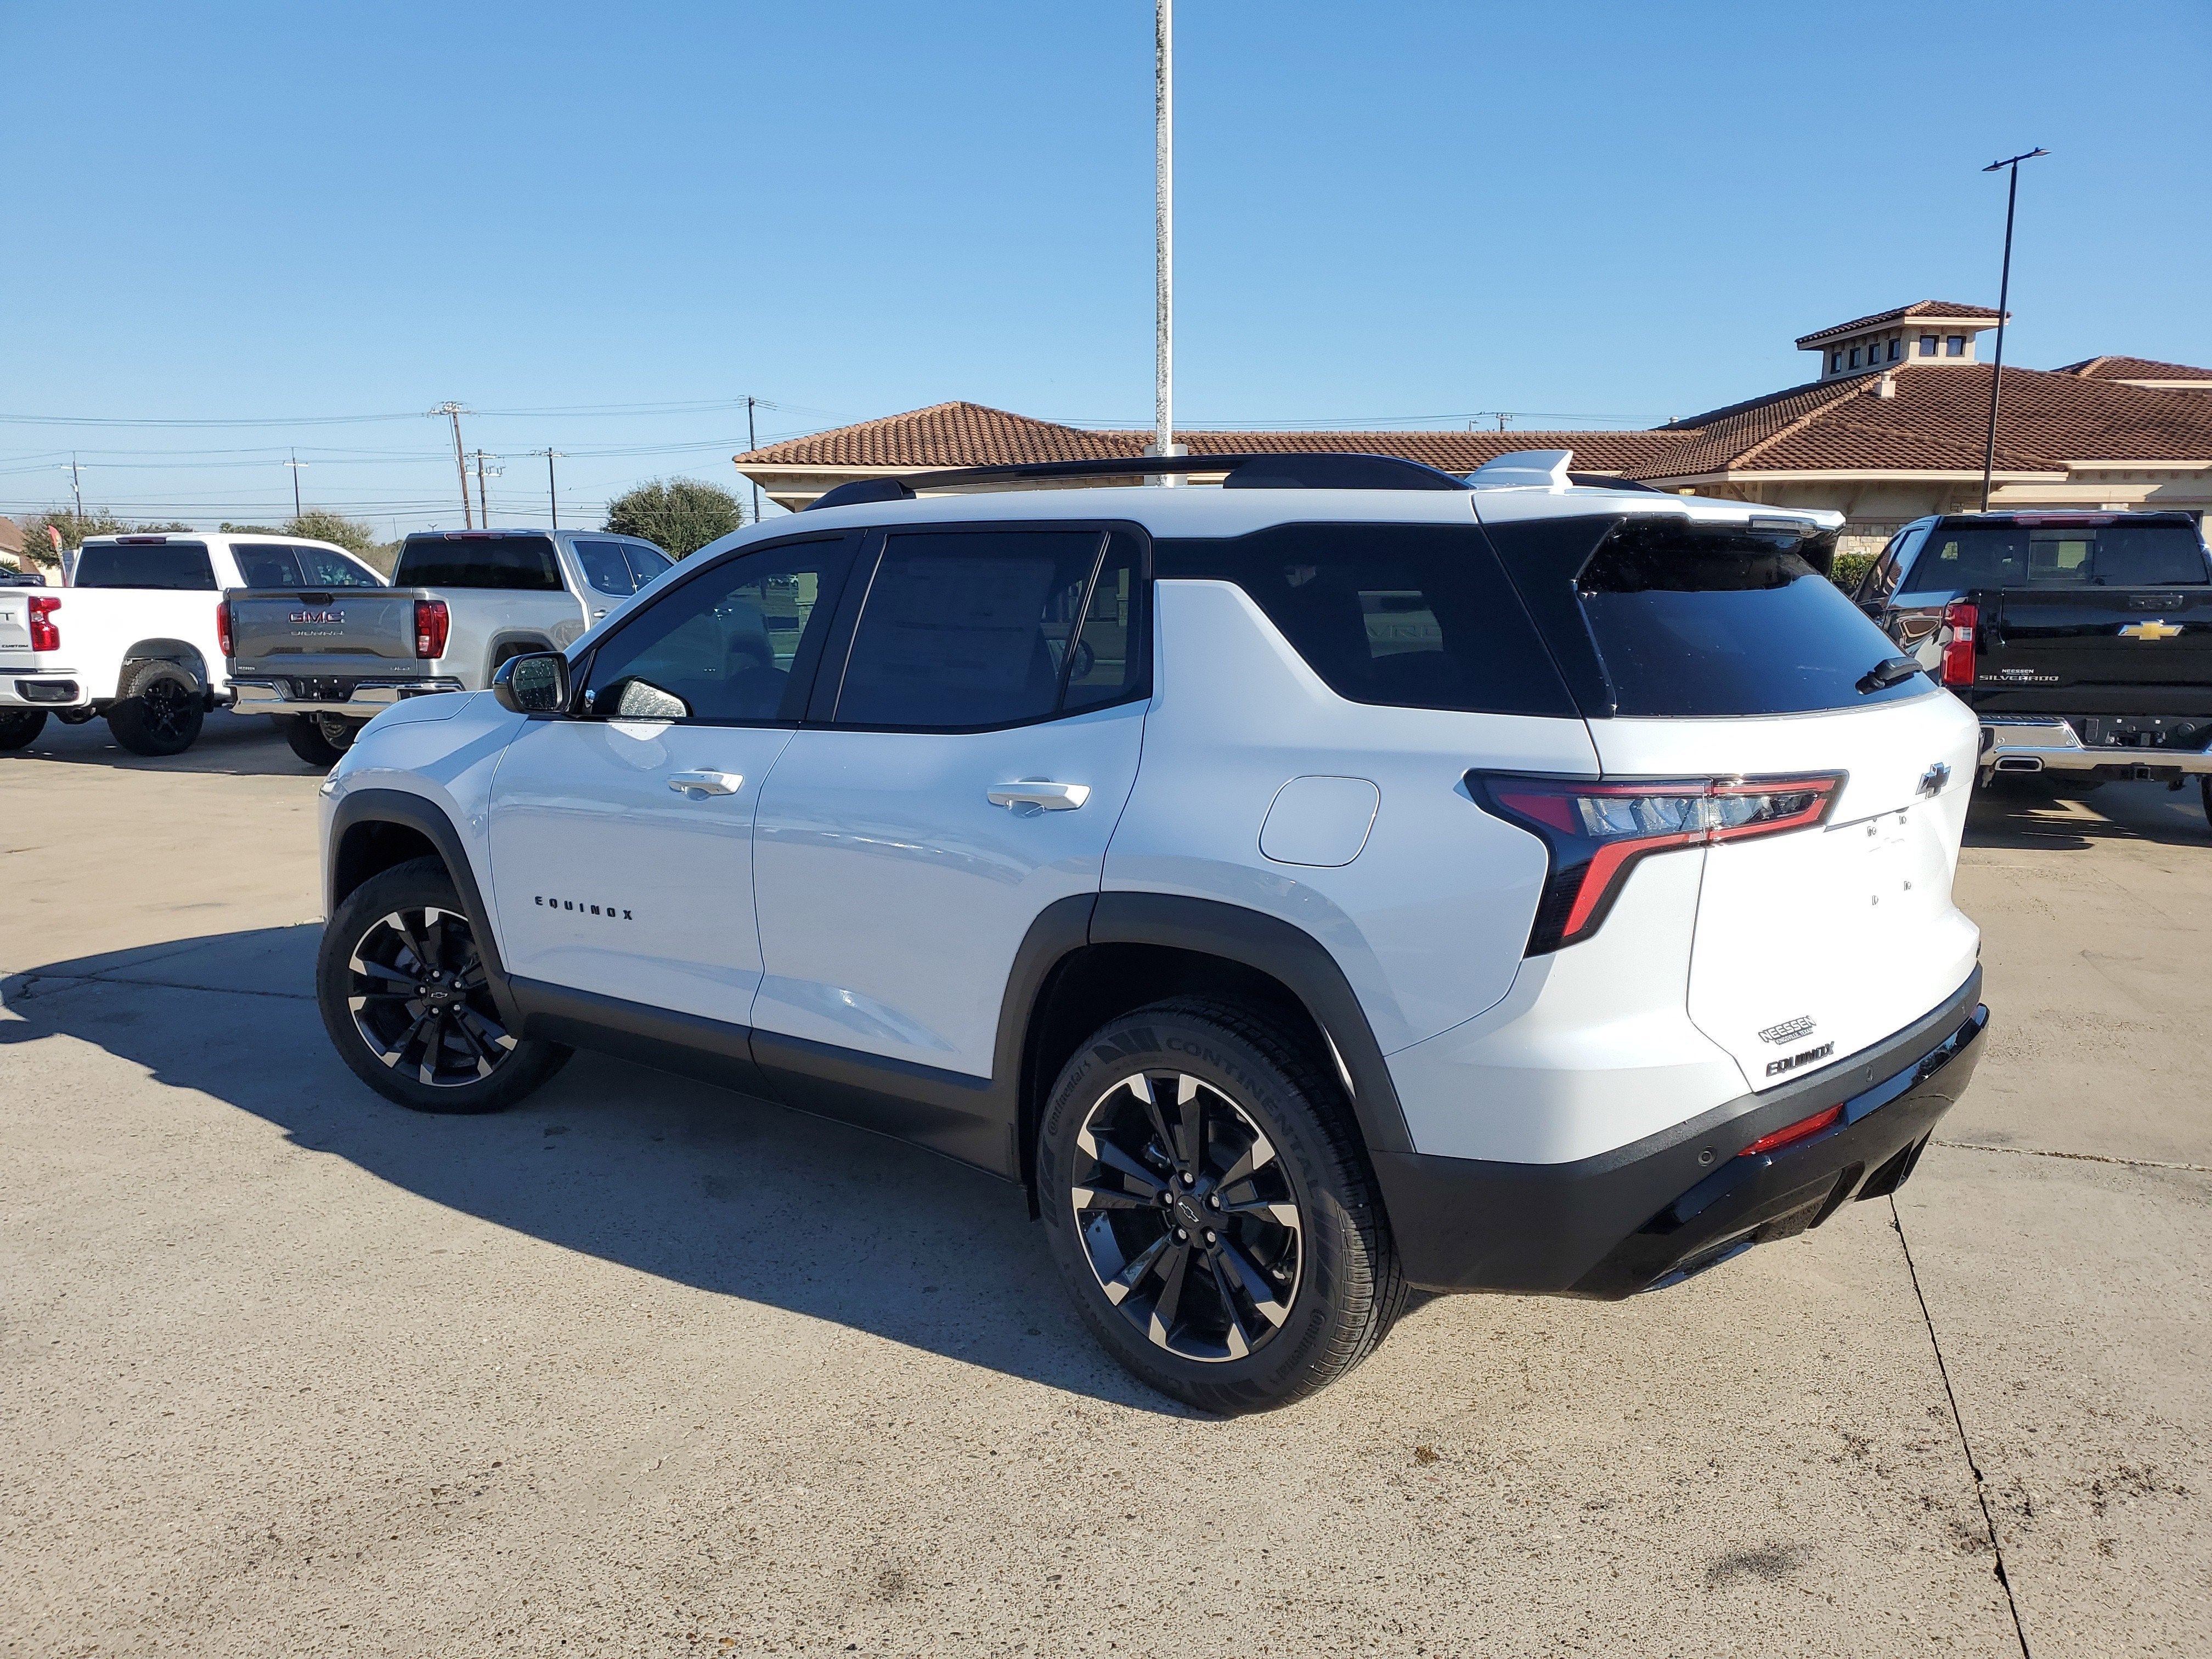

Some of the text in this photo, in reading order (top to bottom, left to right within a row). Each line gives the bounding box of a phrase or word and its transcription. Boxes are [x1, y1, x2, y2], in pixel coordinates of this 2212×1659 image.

[288, 611, 345, 624] GMC
[534, 896, 633, 920] EQUINOX
[1758, 1015, 1817, 1043] NEESSEN
[1765, 1041, 1835, 1077] EQUINOX
